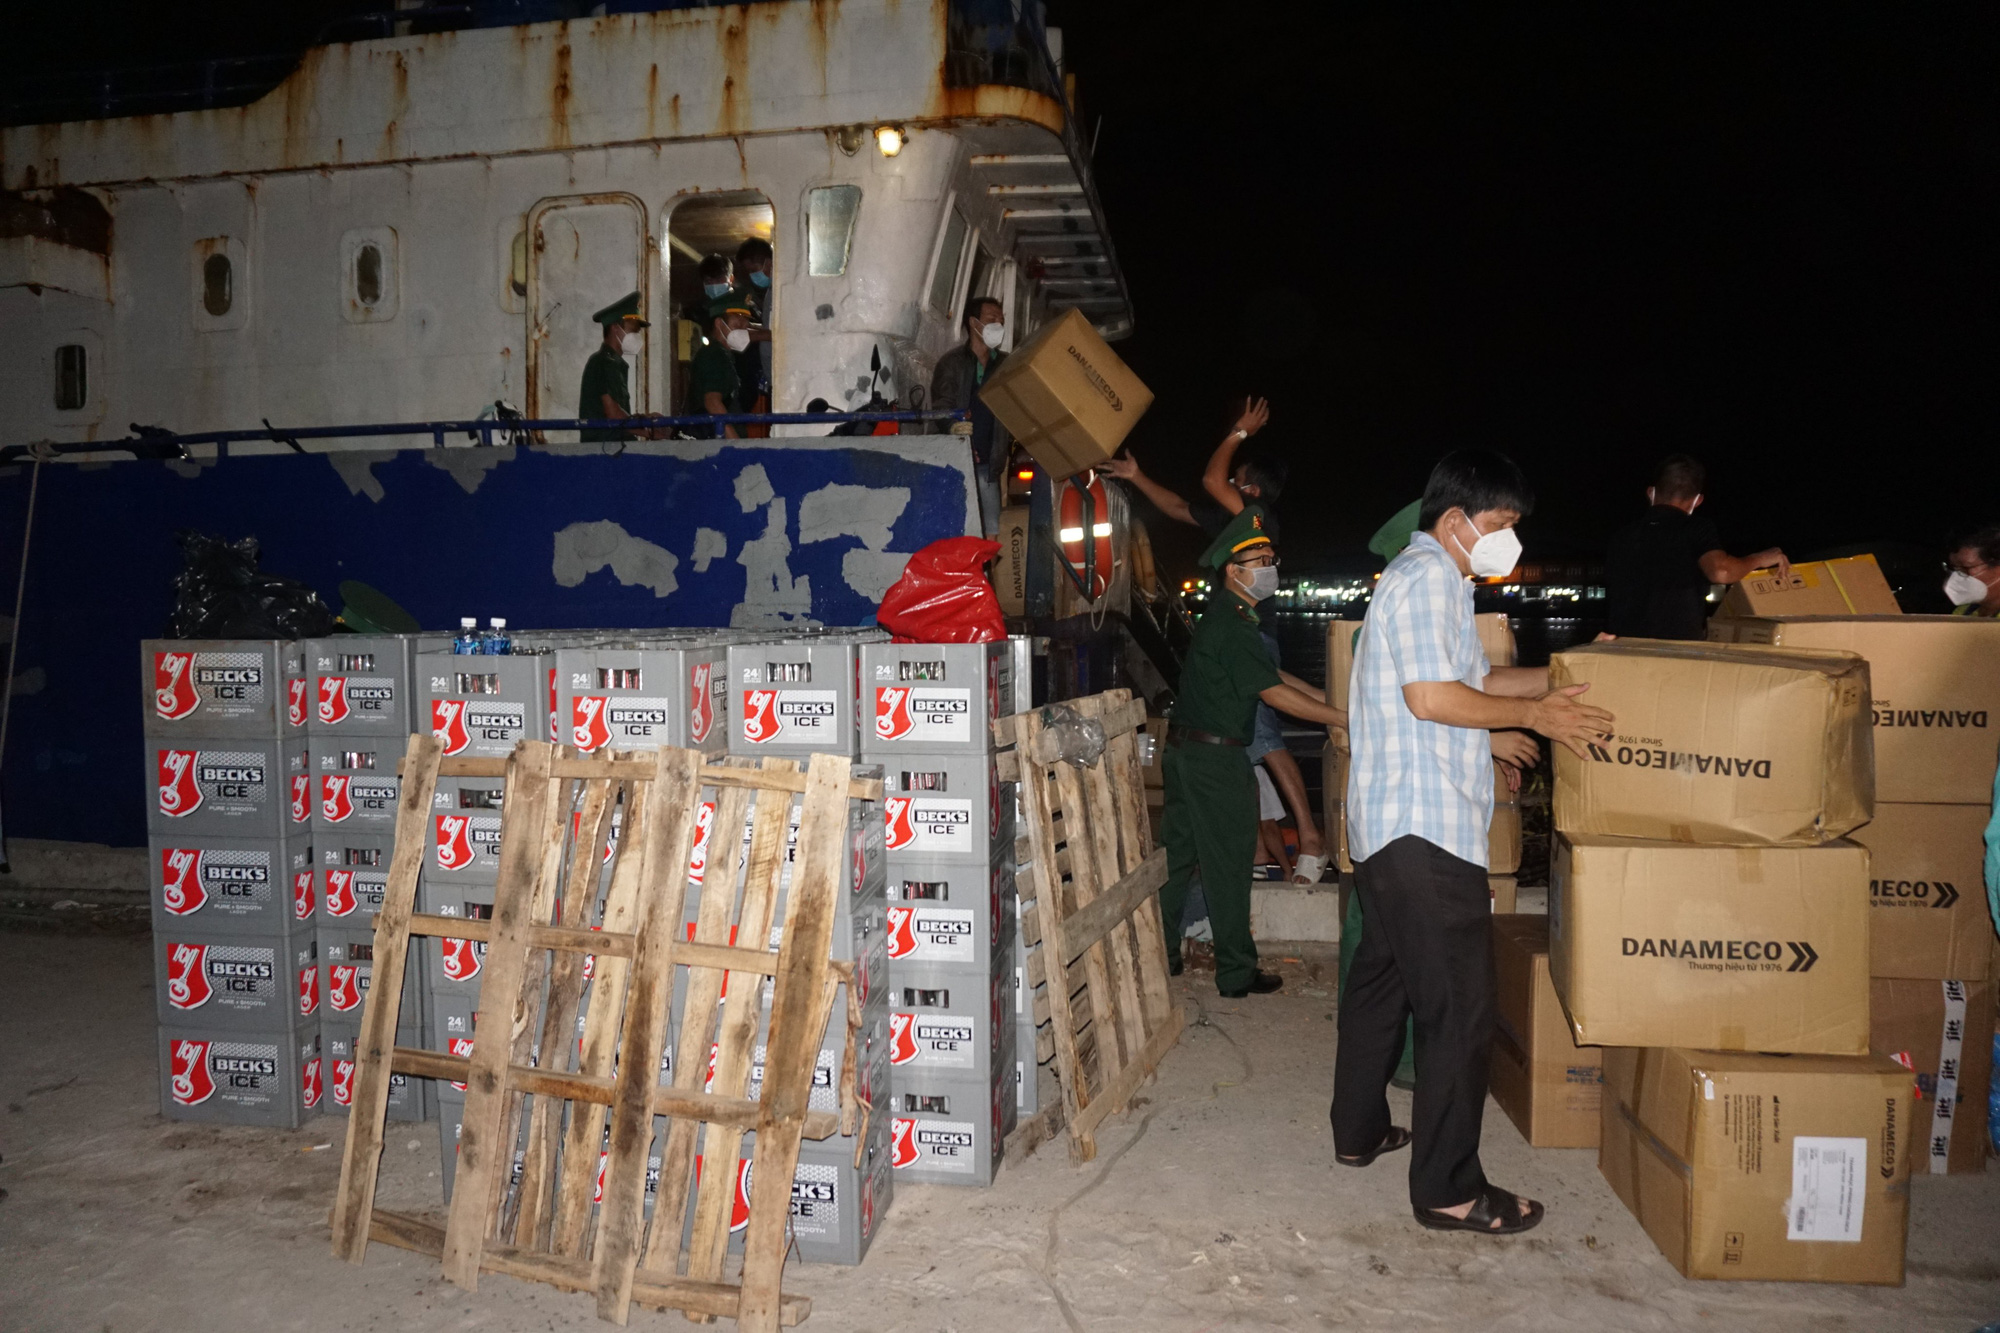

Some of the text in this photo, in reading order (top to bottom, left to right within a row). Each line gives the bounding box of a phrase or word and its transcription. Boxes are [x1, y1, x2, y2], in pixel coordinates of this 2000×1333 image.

[1011, 539, 1023, 599] DANAMECO
[318, 657, 330, 666] 24
[200, 668, 260, 683] BECK'S
[743, 668, 758, 678] 24
[876, 665, 890, 675] 24
[431, 676, 446, 687] 24
[572, 673, 588, 683] 24
[213, 686, 246, 699] ICE
[350, 688, 392, 699] BECK'S
[359, 700, 382, 710] ICE
[783, 703, 832, 715] BECK'S
[915, 701, 965, 713] BECK'S
[1871, 699, 1890, 708] Sinc
[470, 715, 521, 727] BECK'S
[613, 711, 664, 723] BECK'S
[793, 717, 821, 727] ICE
[926, 714, 953, 724] ICE
[1872, 709, 1988, 728] DANAME
[482, 729, 510, 740] ICE
[624, 725, 652, 736] ICE
[1618, 735, 1663, 747] Since 1976
[321, 756, 334, 765] 24
[1617, 746, 1772, 779] DANAMECO
[203, 768, 262, 782] BECK'S
[217, 785, 249, 798] ICE
[354, 787, 395, 798] BECK'S
[435, 792, 449, 803] 24
[363, 799, 386, 809] ICE
[917, 811, 967, 822] BECK'S
[928, 825, 955, 834] ICE
[475, 831, 501, 843] BEC
[325, 850, 337, 860] 24
[486, 844, 500, 855] IC
[207, 867, 266, 881] BECK'S
[221, 883, 253, 896] ICE
[358, 882, 386, 893] BEC
[1869, 879, 1929, 898] MECO
[440, 905, 455, 915] 24
[919, 921, 970, 933] BECK'S
[930, 935, 957, 944] ICE
[329, 946, 340, 955] 24
[1622, 937, 1783, 960] DANAMECO
[212, 963, 271, 977] BECK'S
[1760, 963, 1782, 972] 1976
[226, 979, 257, 992] ICE
[448, 1016, 462, 1026] 24
[920, 1027, 970, 1039] BECK'S
[332, 1041, 344, 1050] 24
[931, 1041, 958, 1050] ICE
[216, 1058, 274, 1073] BECK'S
[229, 1075, 261, 1088] ICE
[1886, 1098, 1896, 1165] DANAMECO
[920, 1132, 970, 1145] BECK'S
[932, 1146, 958, 1156] ICE
[792, 1183, 832, 1200] CK'S
[788, 1202, 814, 1217] CE
